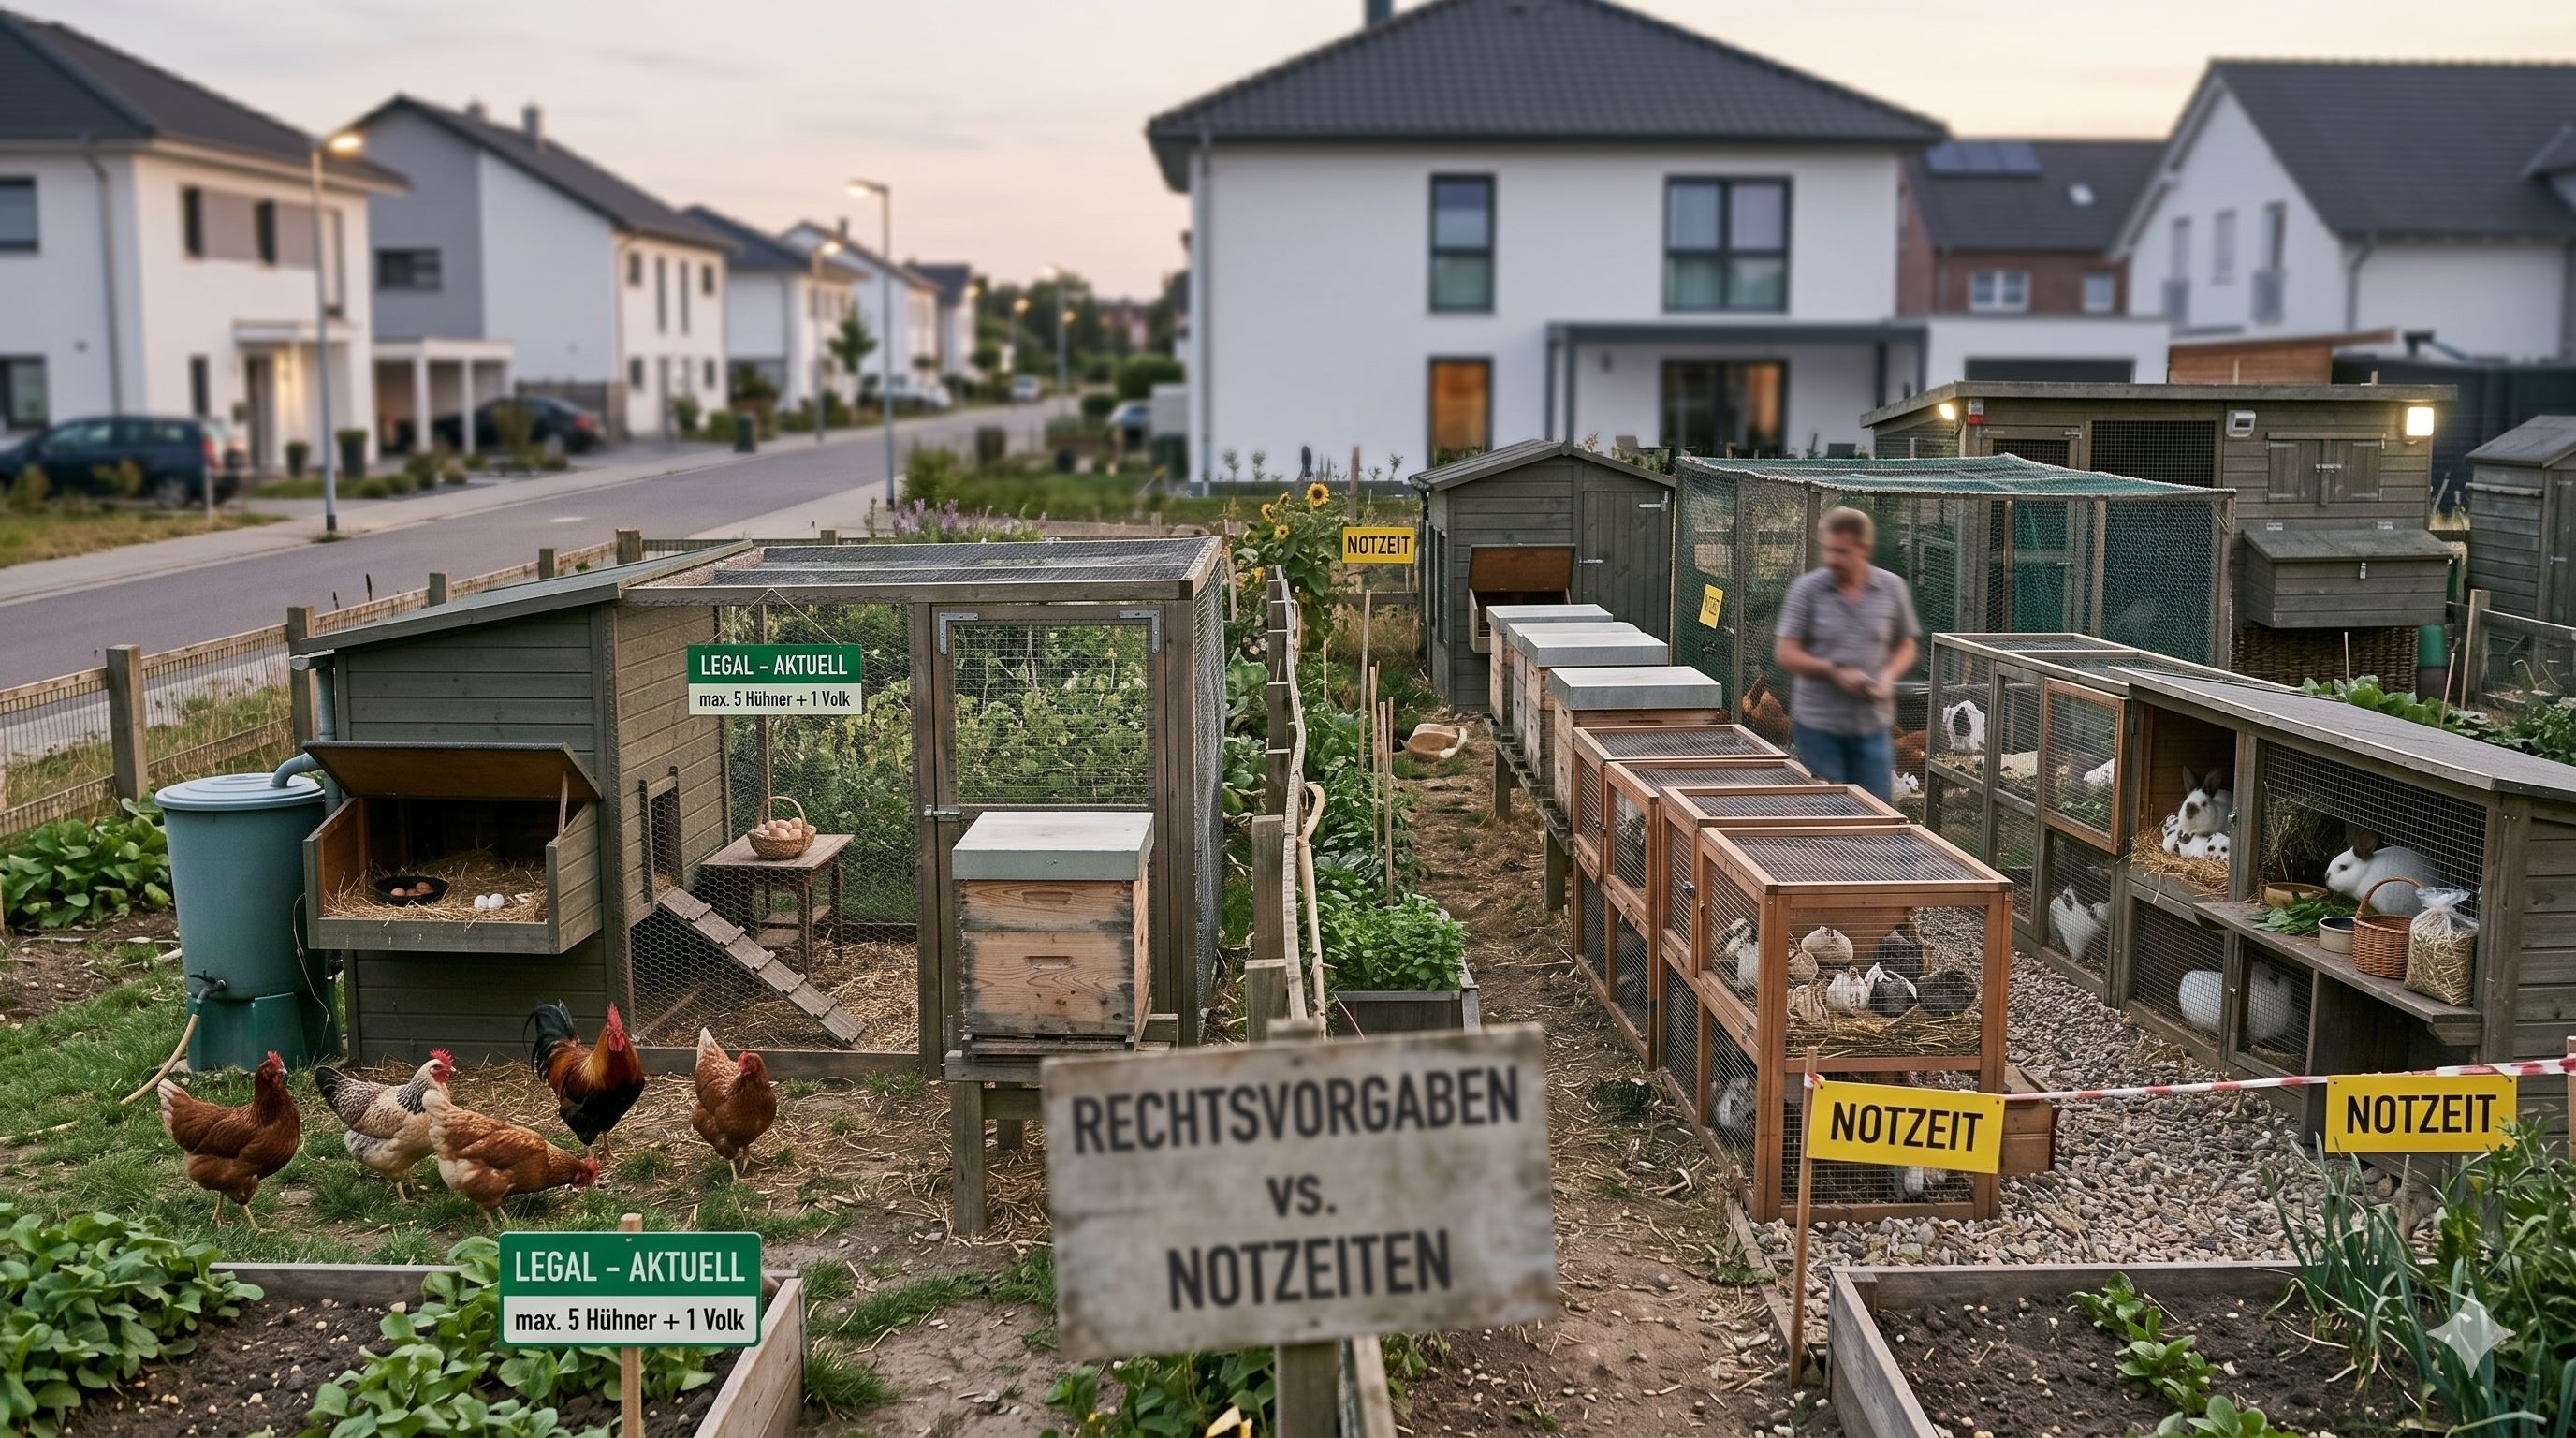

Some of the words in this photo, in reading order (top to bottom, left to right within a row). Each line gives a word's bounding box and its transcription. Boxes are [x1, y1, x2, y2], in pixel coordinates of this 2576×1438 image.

[1348, 536, 1411, 554] NOTZEIT
[701, 655, 754, 675] LEGAL
[774, 655, 848, 675] AKTUELL
[699, 695, 730, 707] max.
[734, 691, 741, 707] 5
[746, 691, 793, 707] Hühner
[796, 695, 807, 707] +
[811, 691, 817, 707] 1
[822, 691, 851, 707] Volk
[1072, 1064, 1520, 1155] RECHTSVORGABEN
[2347, 1094, 2496, 1134] NOTZEIT
[1830, 1102, 1983, 1152] NOTZEIT
[515, 1251, 597, 1282] LEGAL
[629, 1251, 745, 1282] AKTUELL
[1166, 1227, 1452, 1311] NOTZEITEN
[515, 1314, 562, 1331] max.
[568, 1308, 579, 1331] 5
[587, 1308, 656, 1331] Hühner
[663, 1318, 680, 1331] +
[686, 1308, 695, 1331] 1
[704, 1308, 745, 1331] Volk
